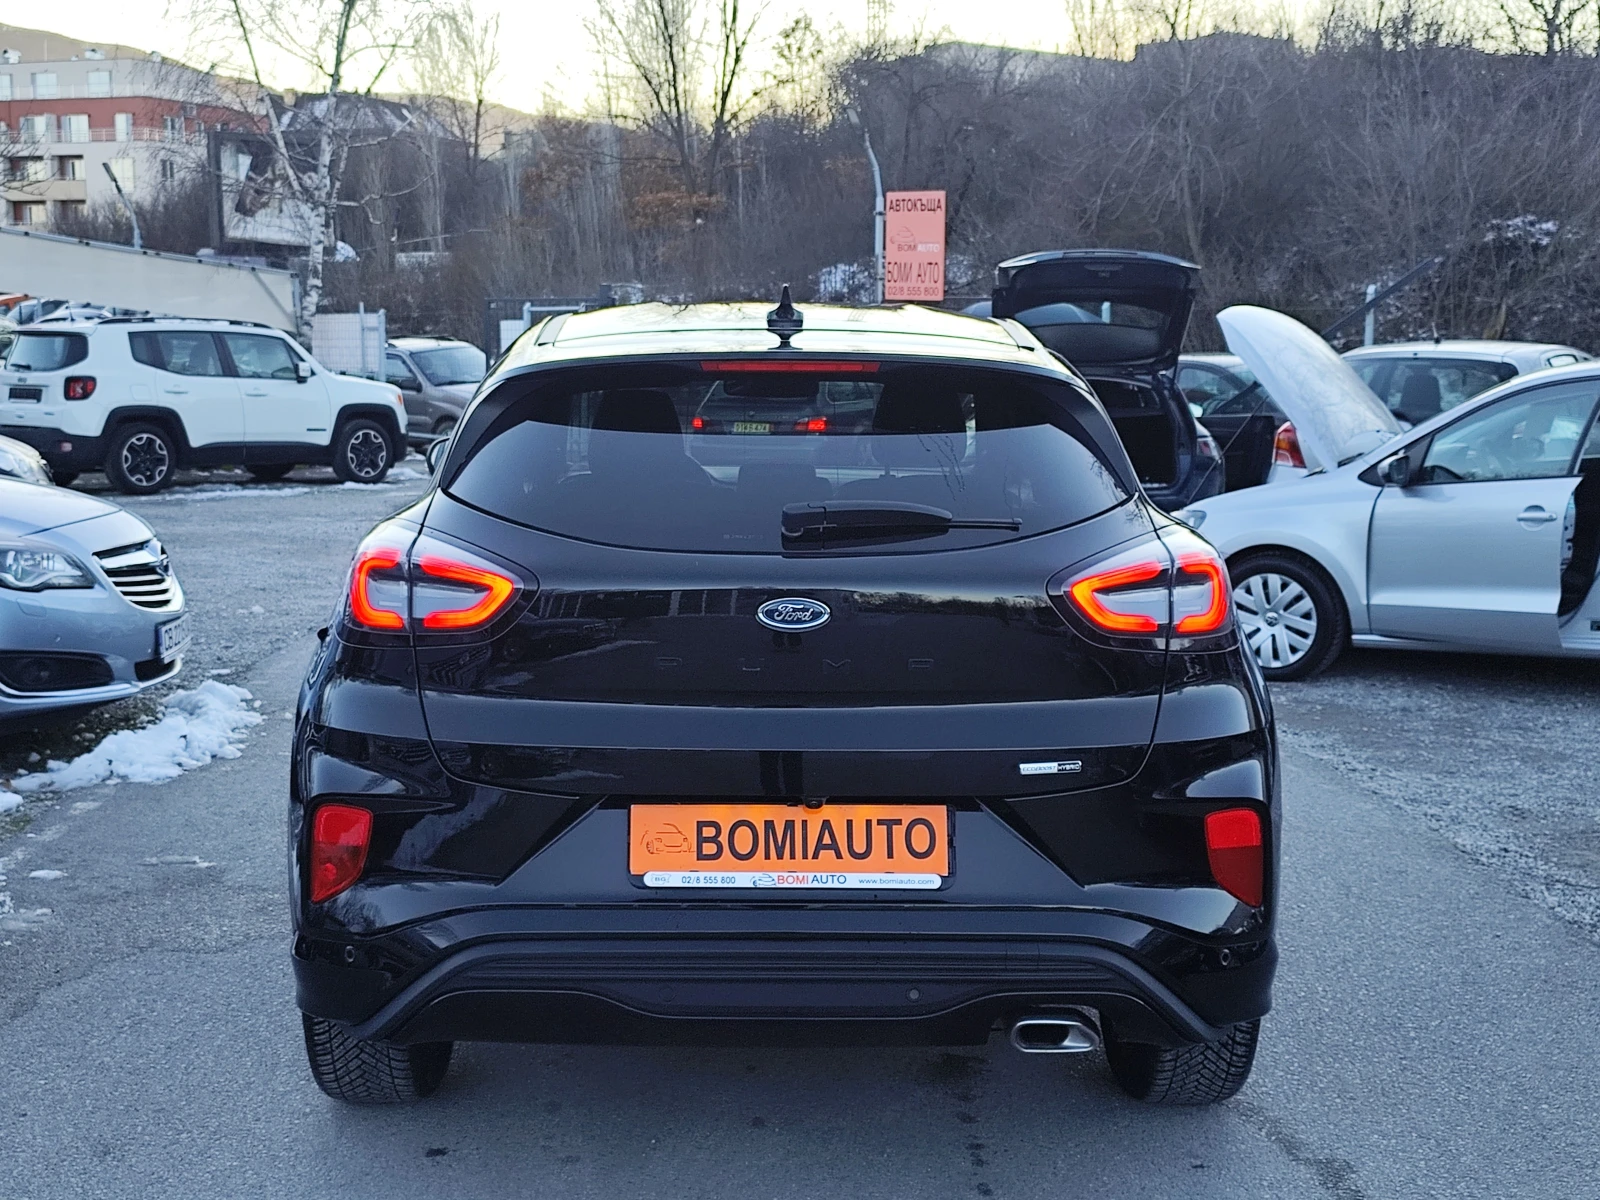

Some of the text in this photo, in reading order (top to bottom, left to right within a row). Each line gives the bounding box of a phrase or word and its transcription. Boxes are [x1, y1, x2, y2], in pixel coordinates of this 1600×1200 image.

[889, 198, 942, 213] АВТОКЪЩА
[887, 262, 940, 283] БОМИ АУТО
[907, 286, 921, 296] 555
[923, 287, 939, 296] 800
[774, 604, 813, 621] Ford
[696, 817, 937, 861] BOMIAUTO
[681, 876, 700, 885] 02/8
[703, 876, 719, 885] 555
[720, 876, 736, 885] 800
[777, 874, 808, 885] BOMI
[811, 874, 847, 885] AUTO
[858, 877, 935, 885] www.bomiauto.com
